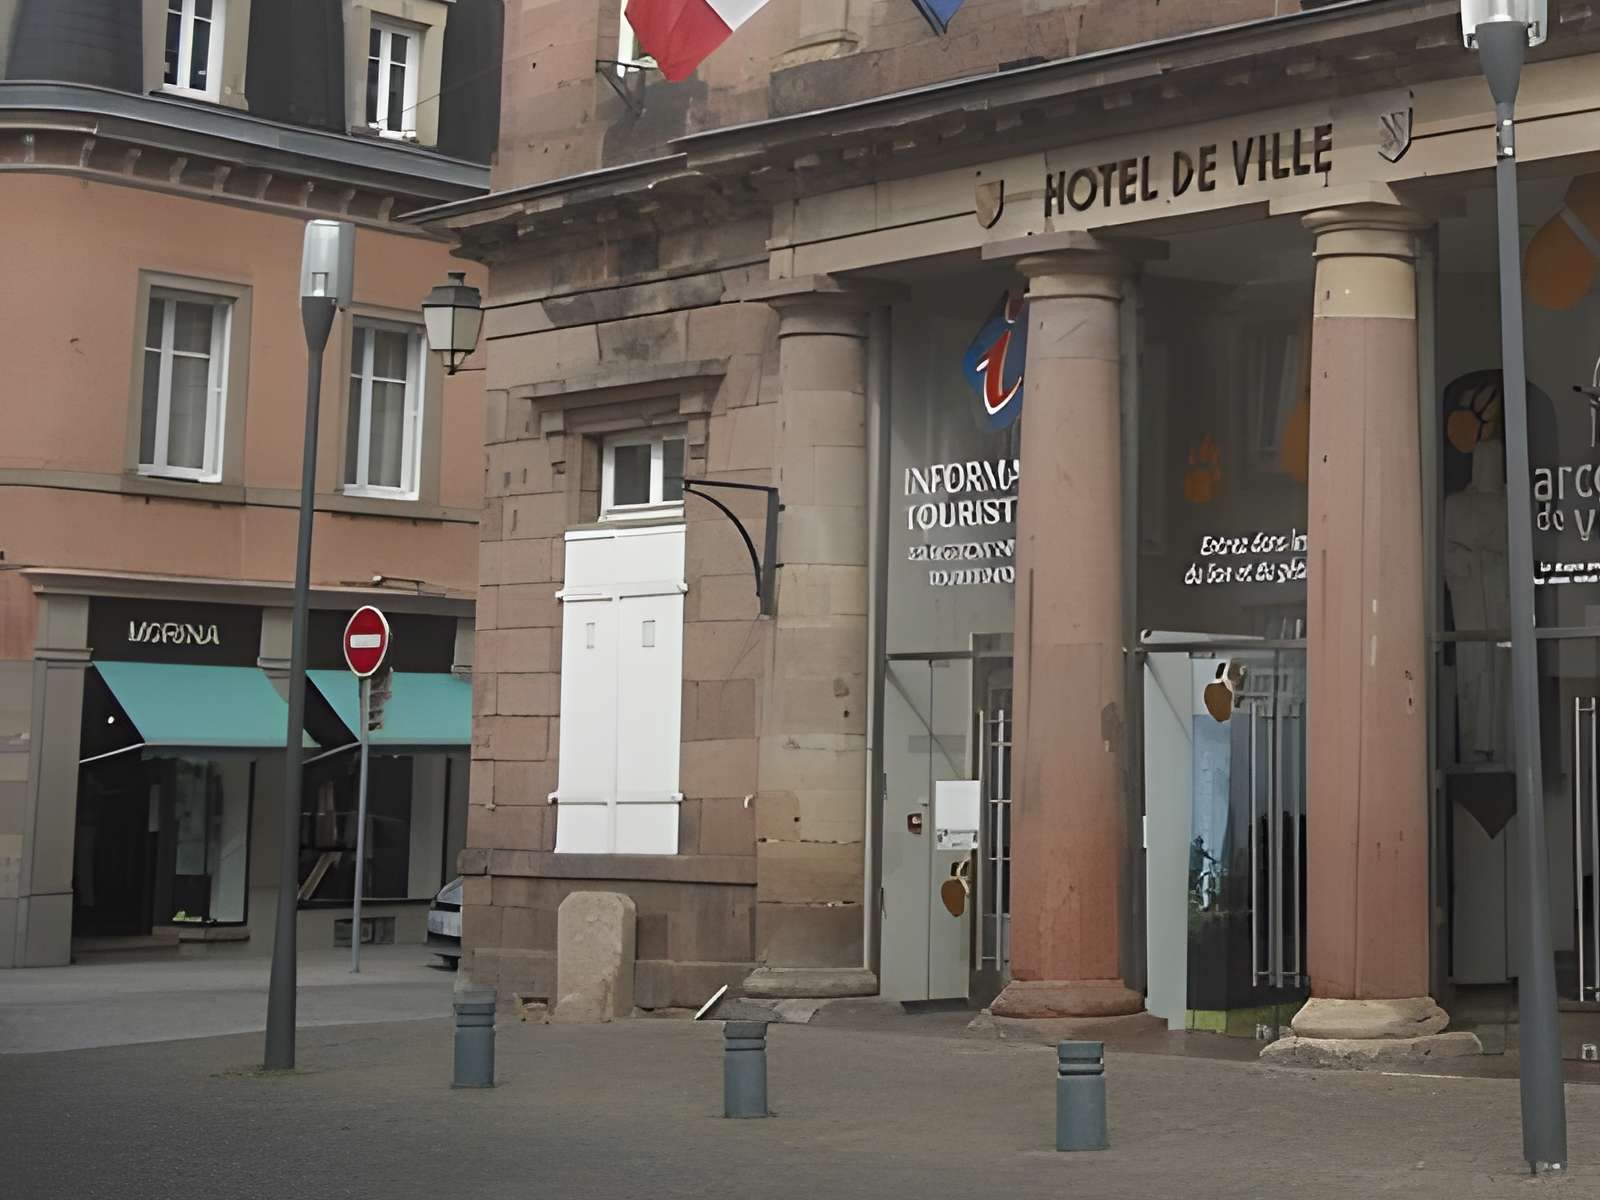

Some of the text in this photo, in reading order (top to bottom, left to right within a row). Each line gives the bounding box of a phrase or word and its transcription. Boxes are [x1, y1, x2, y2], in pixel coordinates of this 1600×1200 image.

[1045, 123, 1333, 217] HOTEL DE VILLE
